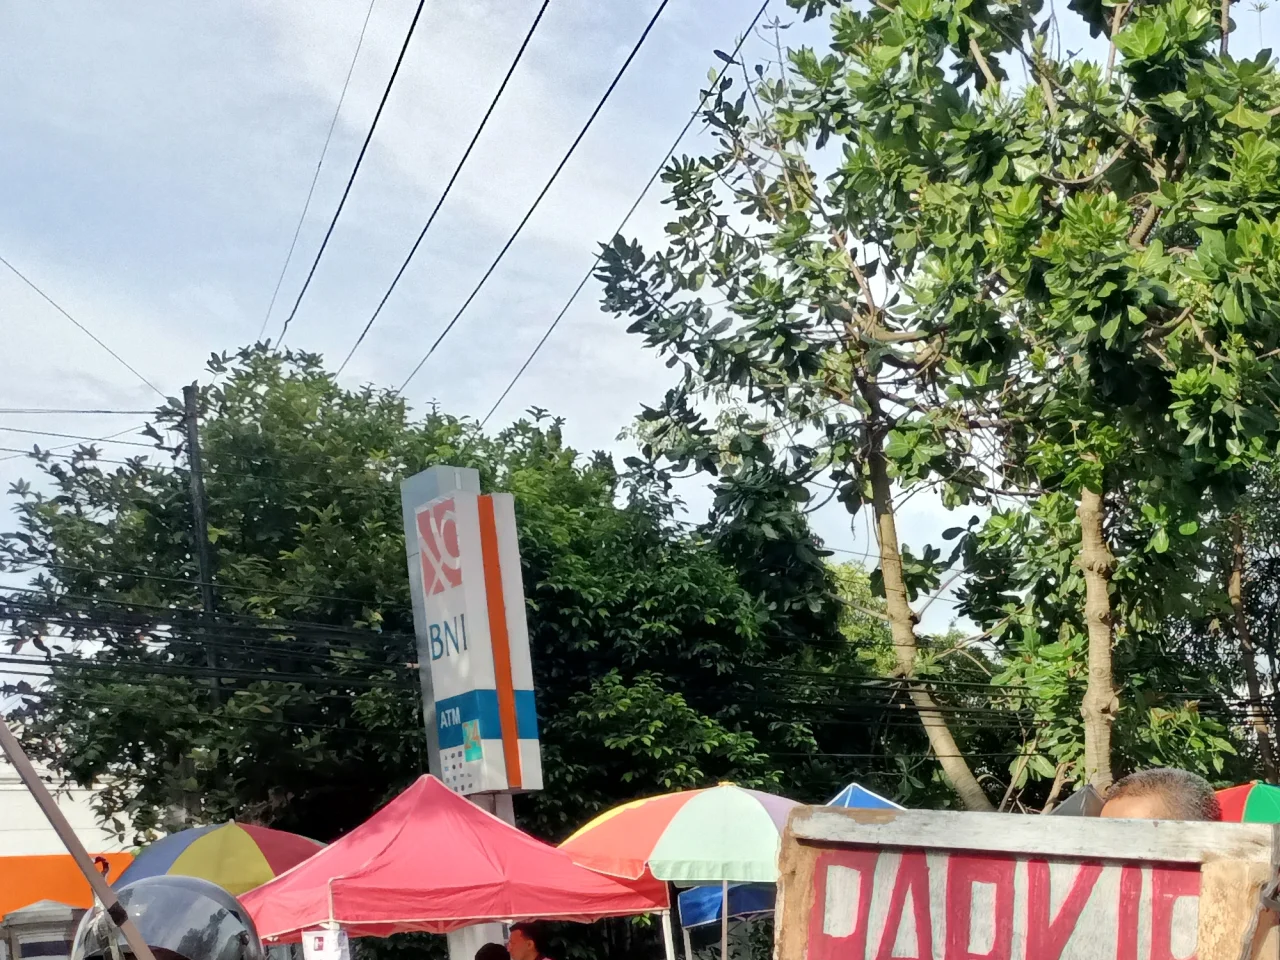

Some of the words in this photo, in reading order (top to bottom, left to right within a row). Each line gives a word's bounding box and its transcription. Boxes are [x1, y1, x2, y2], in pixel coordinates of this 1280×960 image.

[429, 614, 468, 661] BNI
[440, 706, 461, 729] ATM
[463, 721, 480, 749] 24
